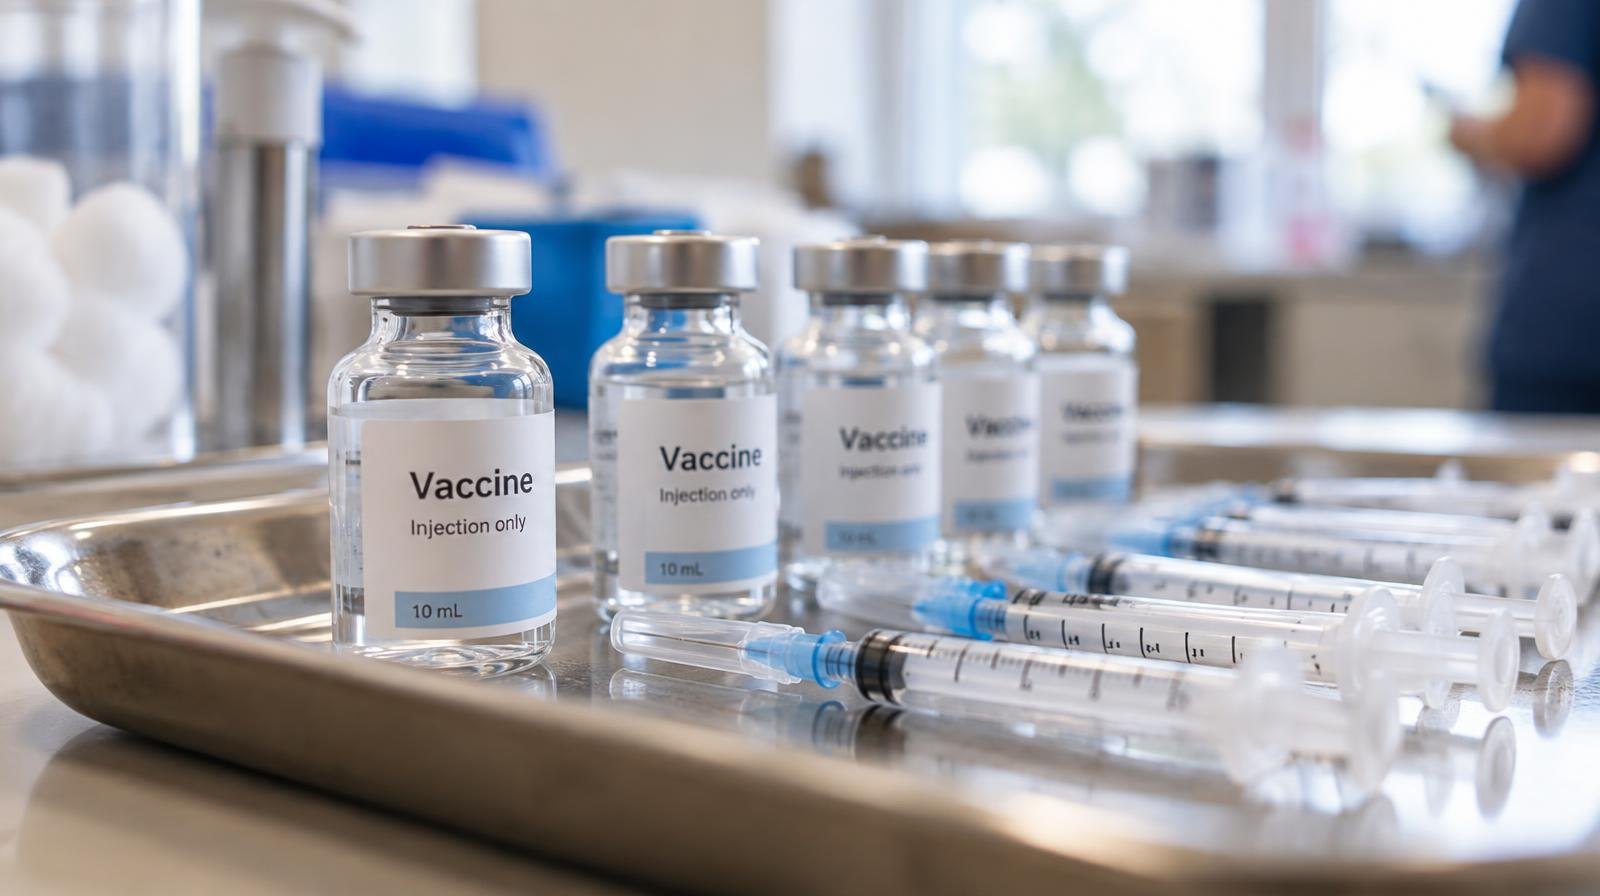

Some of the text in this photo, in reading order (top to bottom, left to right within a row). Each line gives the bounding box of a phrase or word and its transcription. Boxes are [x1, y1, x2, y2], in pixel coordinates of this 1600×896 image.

[660, 444, 762, 472] Vaccine
[409, 468, 533, 500] Vaccine
[660, 488, 727, 505] Injection
[411, 514, 526, 539] Injection only
[660, 563, 704, 576] 10 mL
[413, 604, 463, 619] 10 mL
